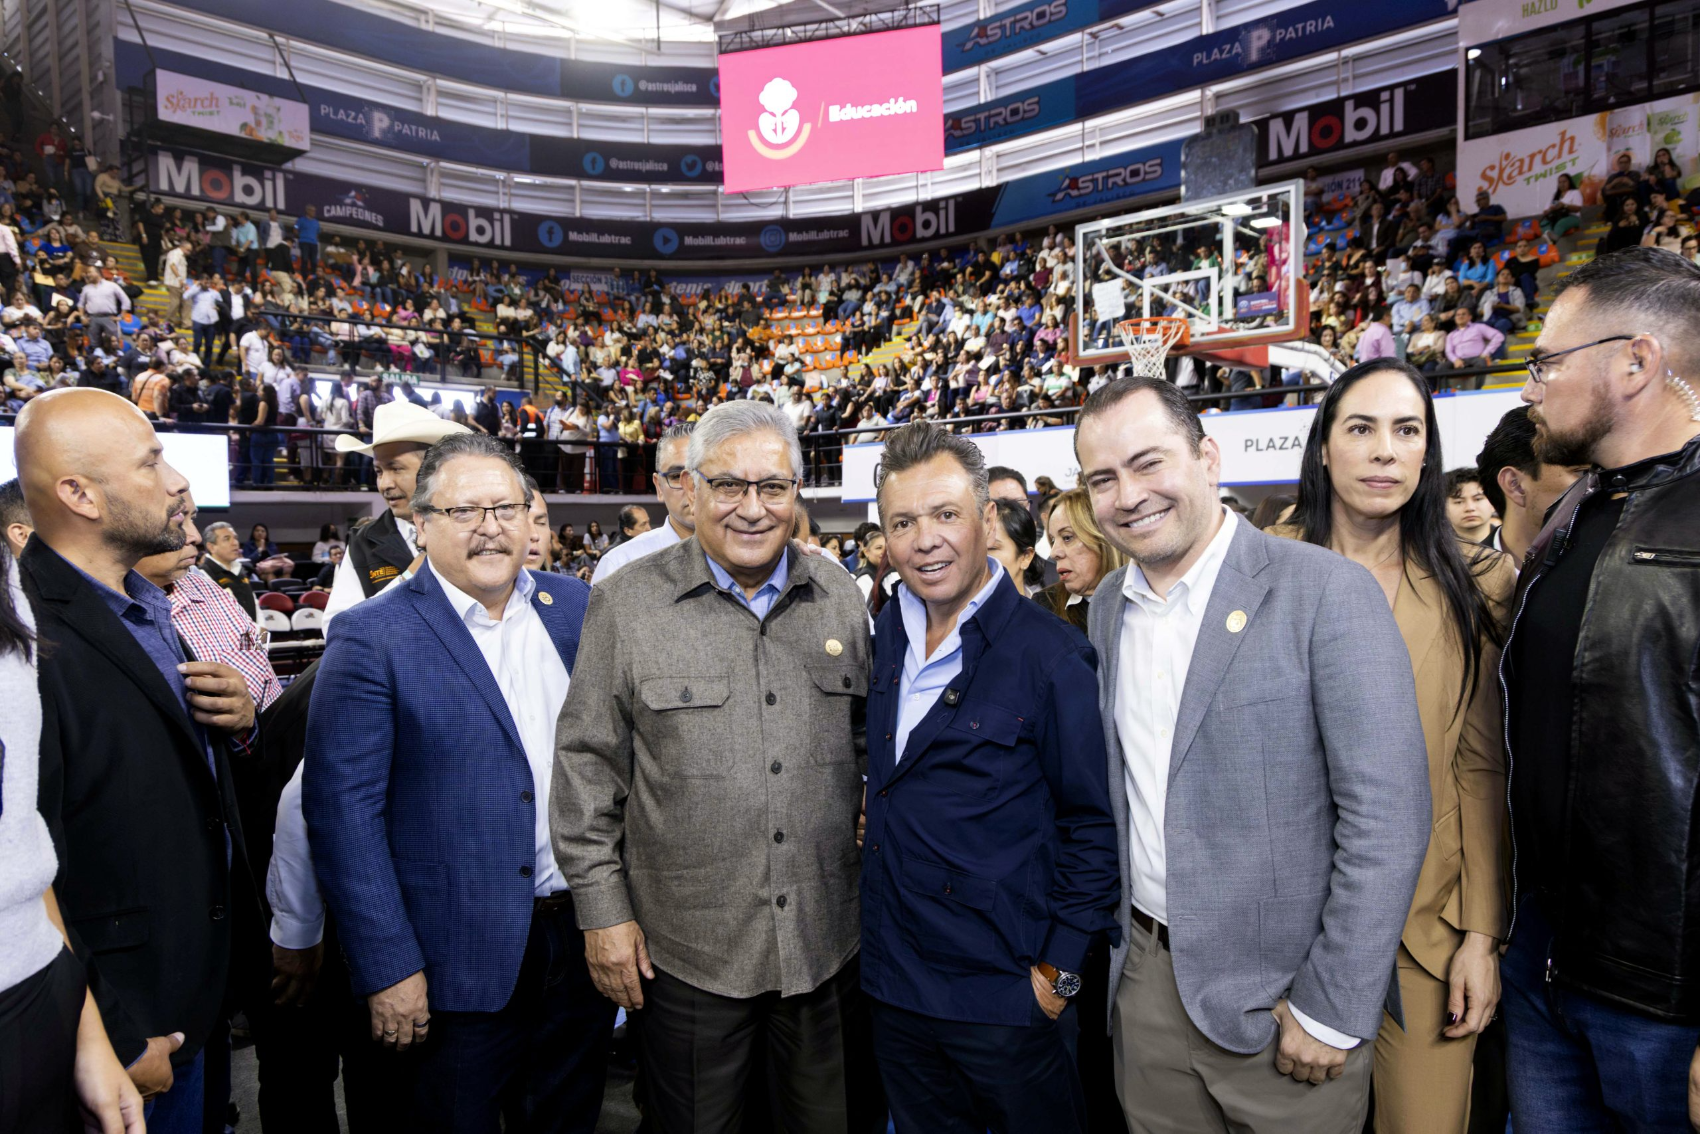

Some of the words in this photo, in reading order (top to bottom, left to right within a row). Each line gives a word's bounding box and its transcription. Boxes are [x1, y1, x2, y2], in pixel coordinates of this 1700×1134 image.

[962, 0, 1067, 51] ASTROS
[1193, 41, 1242, 67] PLAZA
[1276, 15, 1335, 43] PATRIA
[638, 80, 697, 94] @astrosjalisco
[320, 104, 366, 126] PLAZA
[394, 123, 441, 142] PATRIA
[828, 96, 917, 122] Educación
[945, 96, 1040, 140] ASTROS
[1268, 87, 1405, 161] Mobil
[158, 151, 286, 210] Mobil
[609, 157, 668, 172] @astrosjalisco
[1053, 158, 1162, 203] ASTROS
[1523, 156, 1580, 186] TWIST
[323, 205, 384, 227] CAMPEONES
[409, 198, 512, 246] Mobil
[568, 231, 632, 245] MobilLubtrac
[684, 235, 747, 246] MobilLubtrac
[788, 228, 849, 242] MobilLubtrac
[861, 199, 956, 247] Mobil
[1244, 436, 1303, 453] PLAZA
